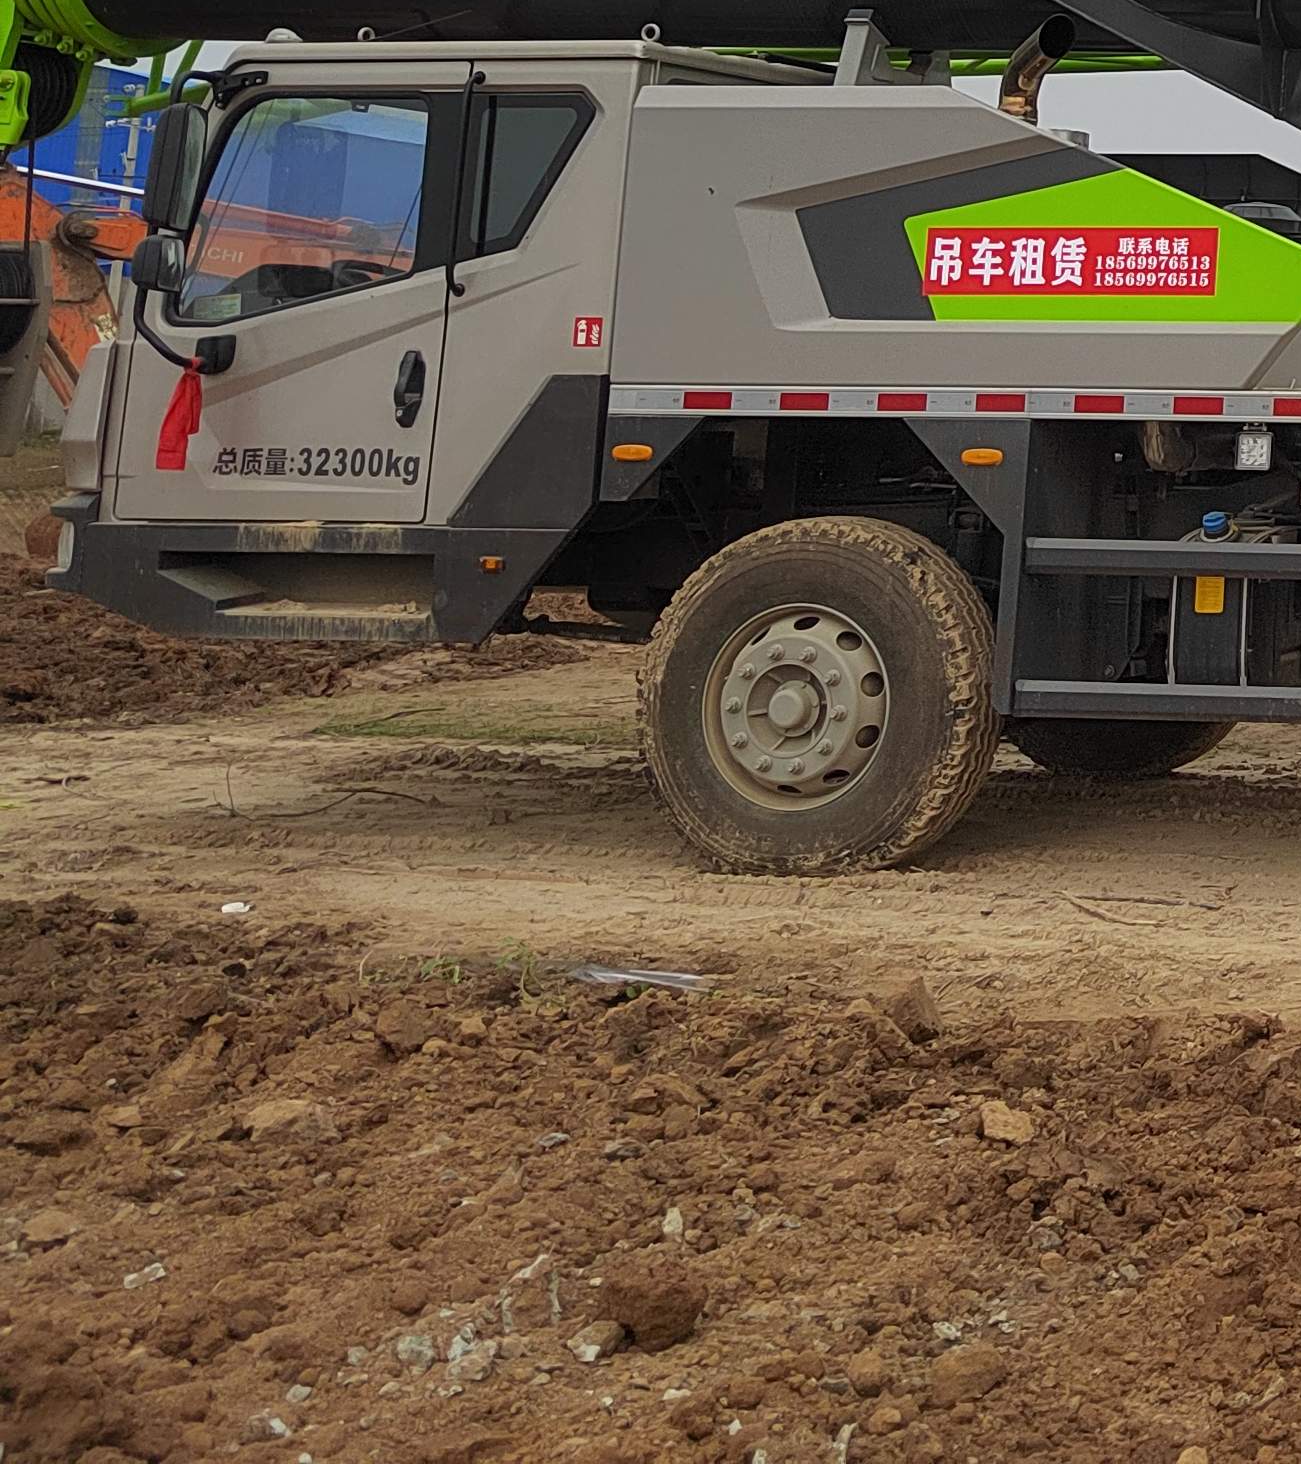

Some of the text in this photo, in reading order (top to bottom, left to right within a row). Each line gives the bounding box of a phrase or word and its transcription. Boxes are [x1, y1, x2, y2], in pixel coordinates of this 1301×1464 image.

[1118, 236, 1190, 256] 联系电话
[929, 236, 1088, 287] 吊车租赁
[1095, 255, 1211, 271] 18569976513
[1093, 271, 1210, 287] 18569976515
[212, 447, 421, 486] 总质量:32300kg
